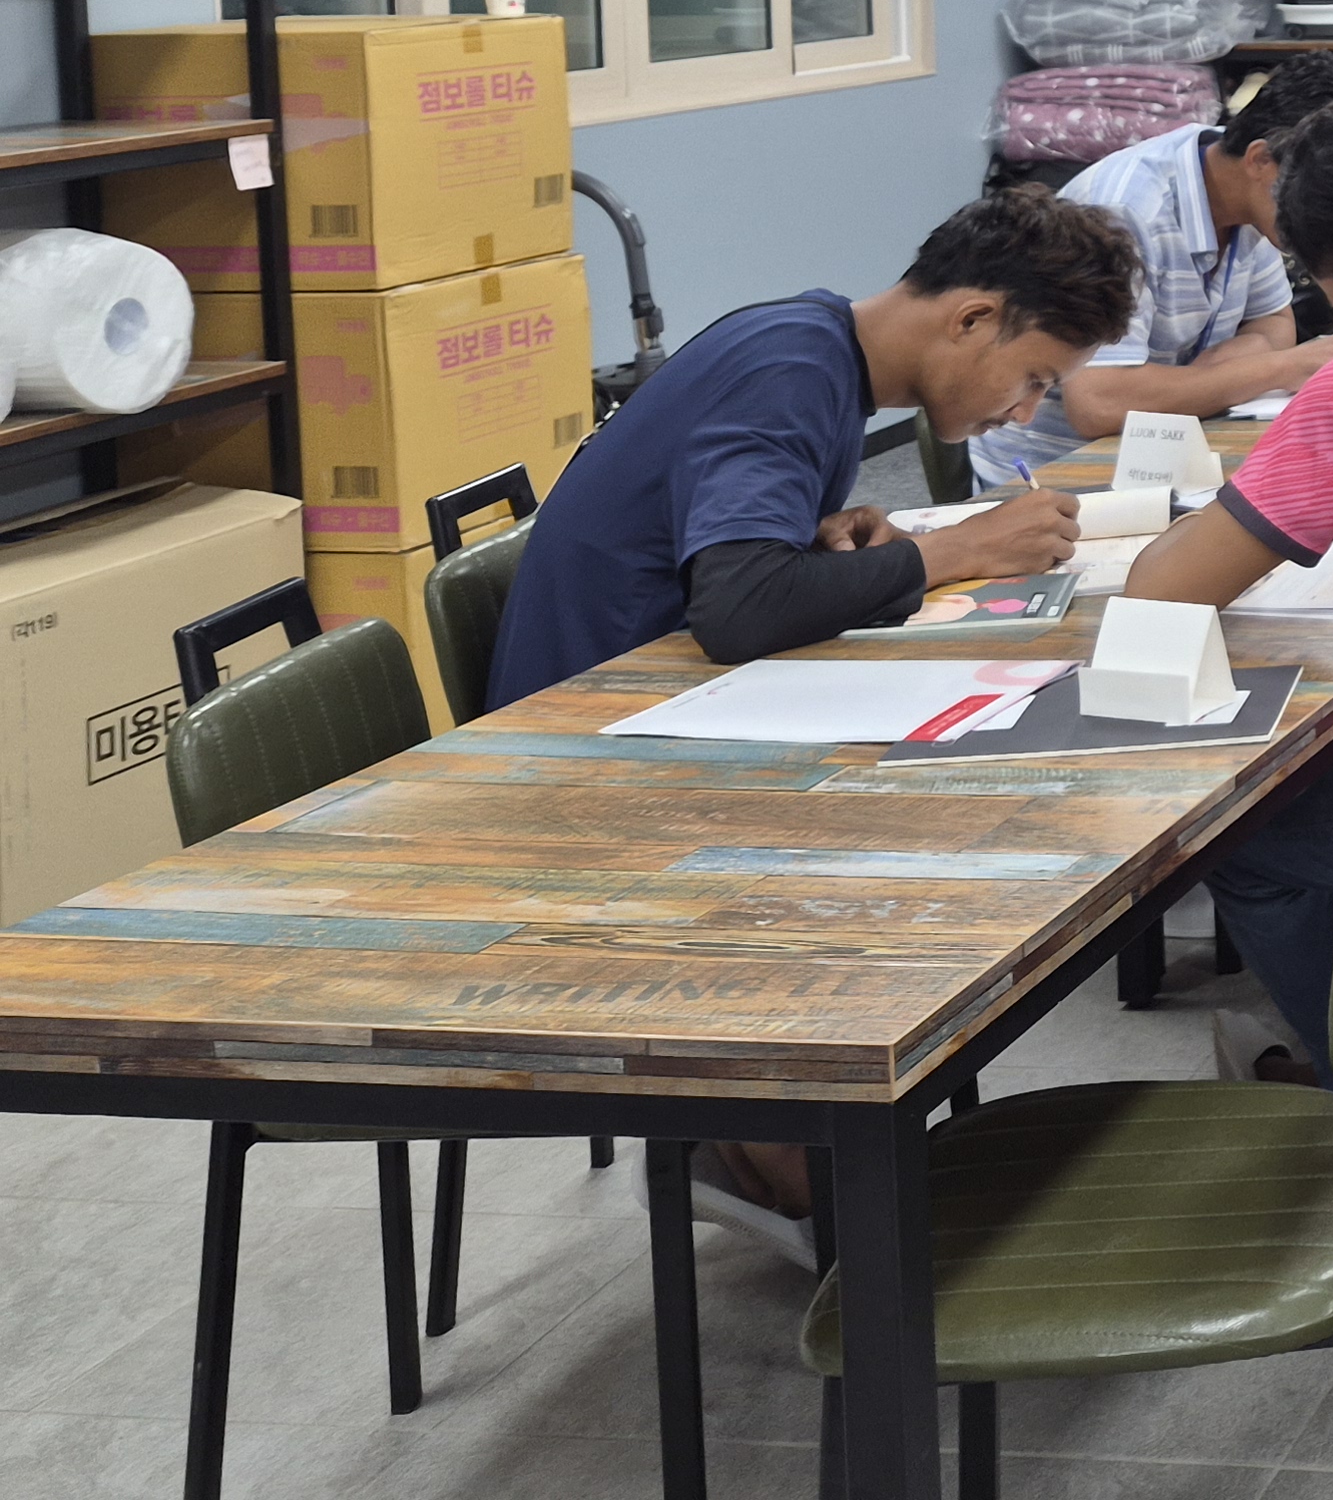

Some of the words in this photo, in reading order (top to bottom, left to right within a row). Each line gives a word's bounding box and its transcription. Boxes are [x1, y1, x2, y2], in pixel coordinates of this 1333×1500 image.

[418, 75, 486, 114] 점보롤
[491, 70, 536, 102] 티슈
[437, 324, 503, 370] 점보롤
[509, 313, 556, 348] 티슈
